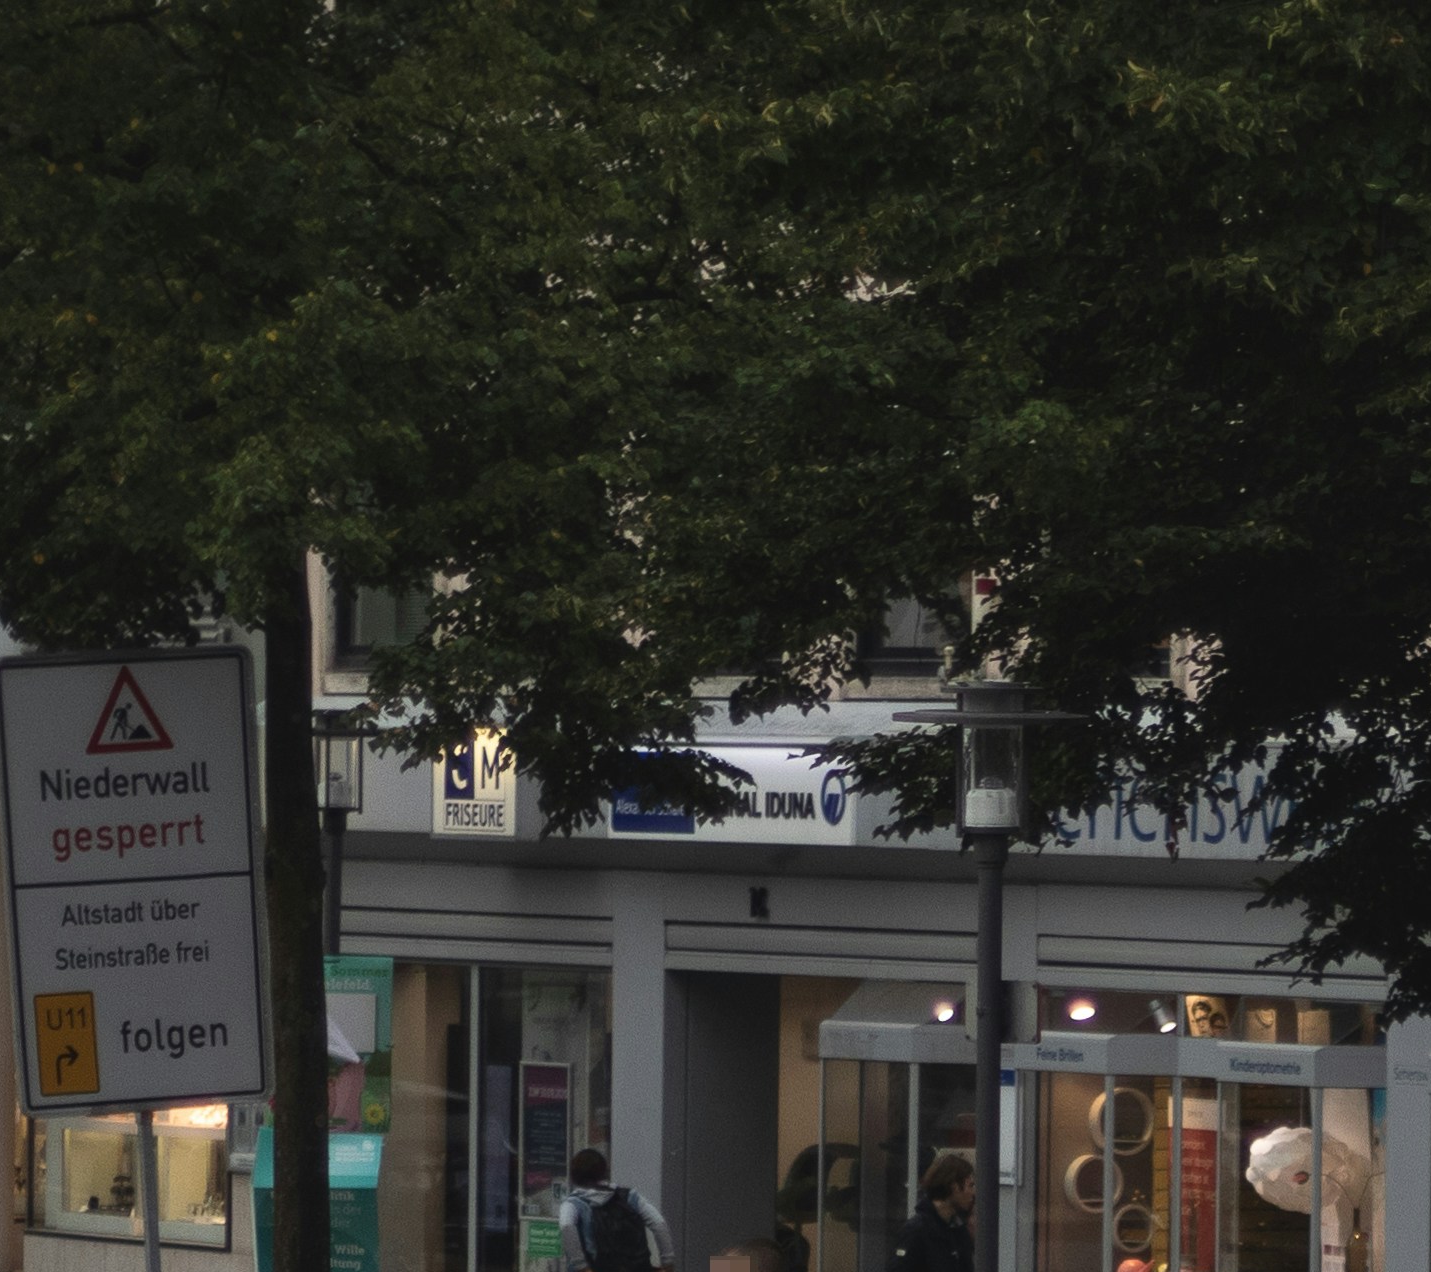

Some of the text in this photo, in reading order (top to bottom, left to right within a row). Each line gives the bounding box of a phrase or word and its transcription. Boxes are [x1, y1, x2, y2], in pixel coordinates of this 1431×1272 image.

[40, 762, 210, 801] Niederwall
[445, 801, 505, 828] FRISEURE
[765, 792, 817, 820] IDUNA
[52, 814, 205, 862] gesperrt
[61, 899, 200, 927] Altstadt über
[55, 940, 210, 970] Steinstraße frei
[45, 1007, 88, 1032] U11
[120, 1018, 229, 1058] folgen
